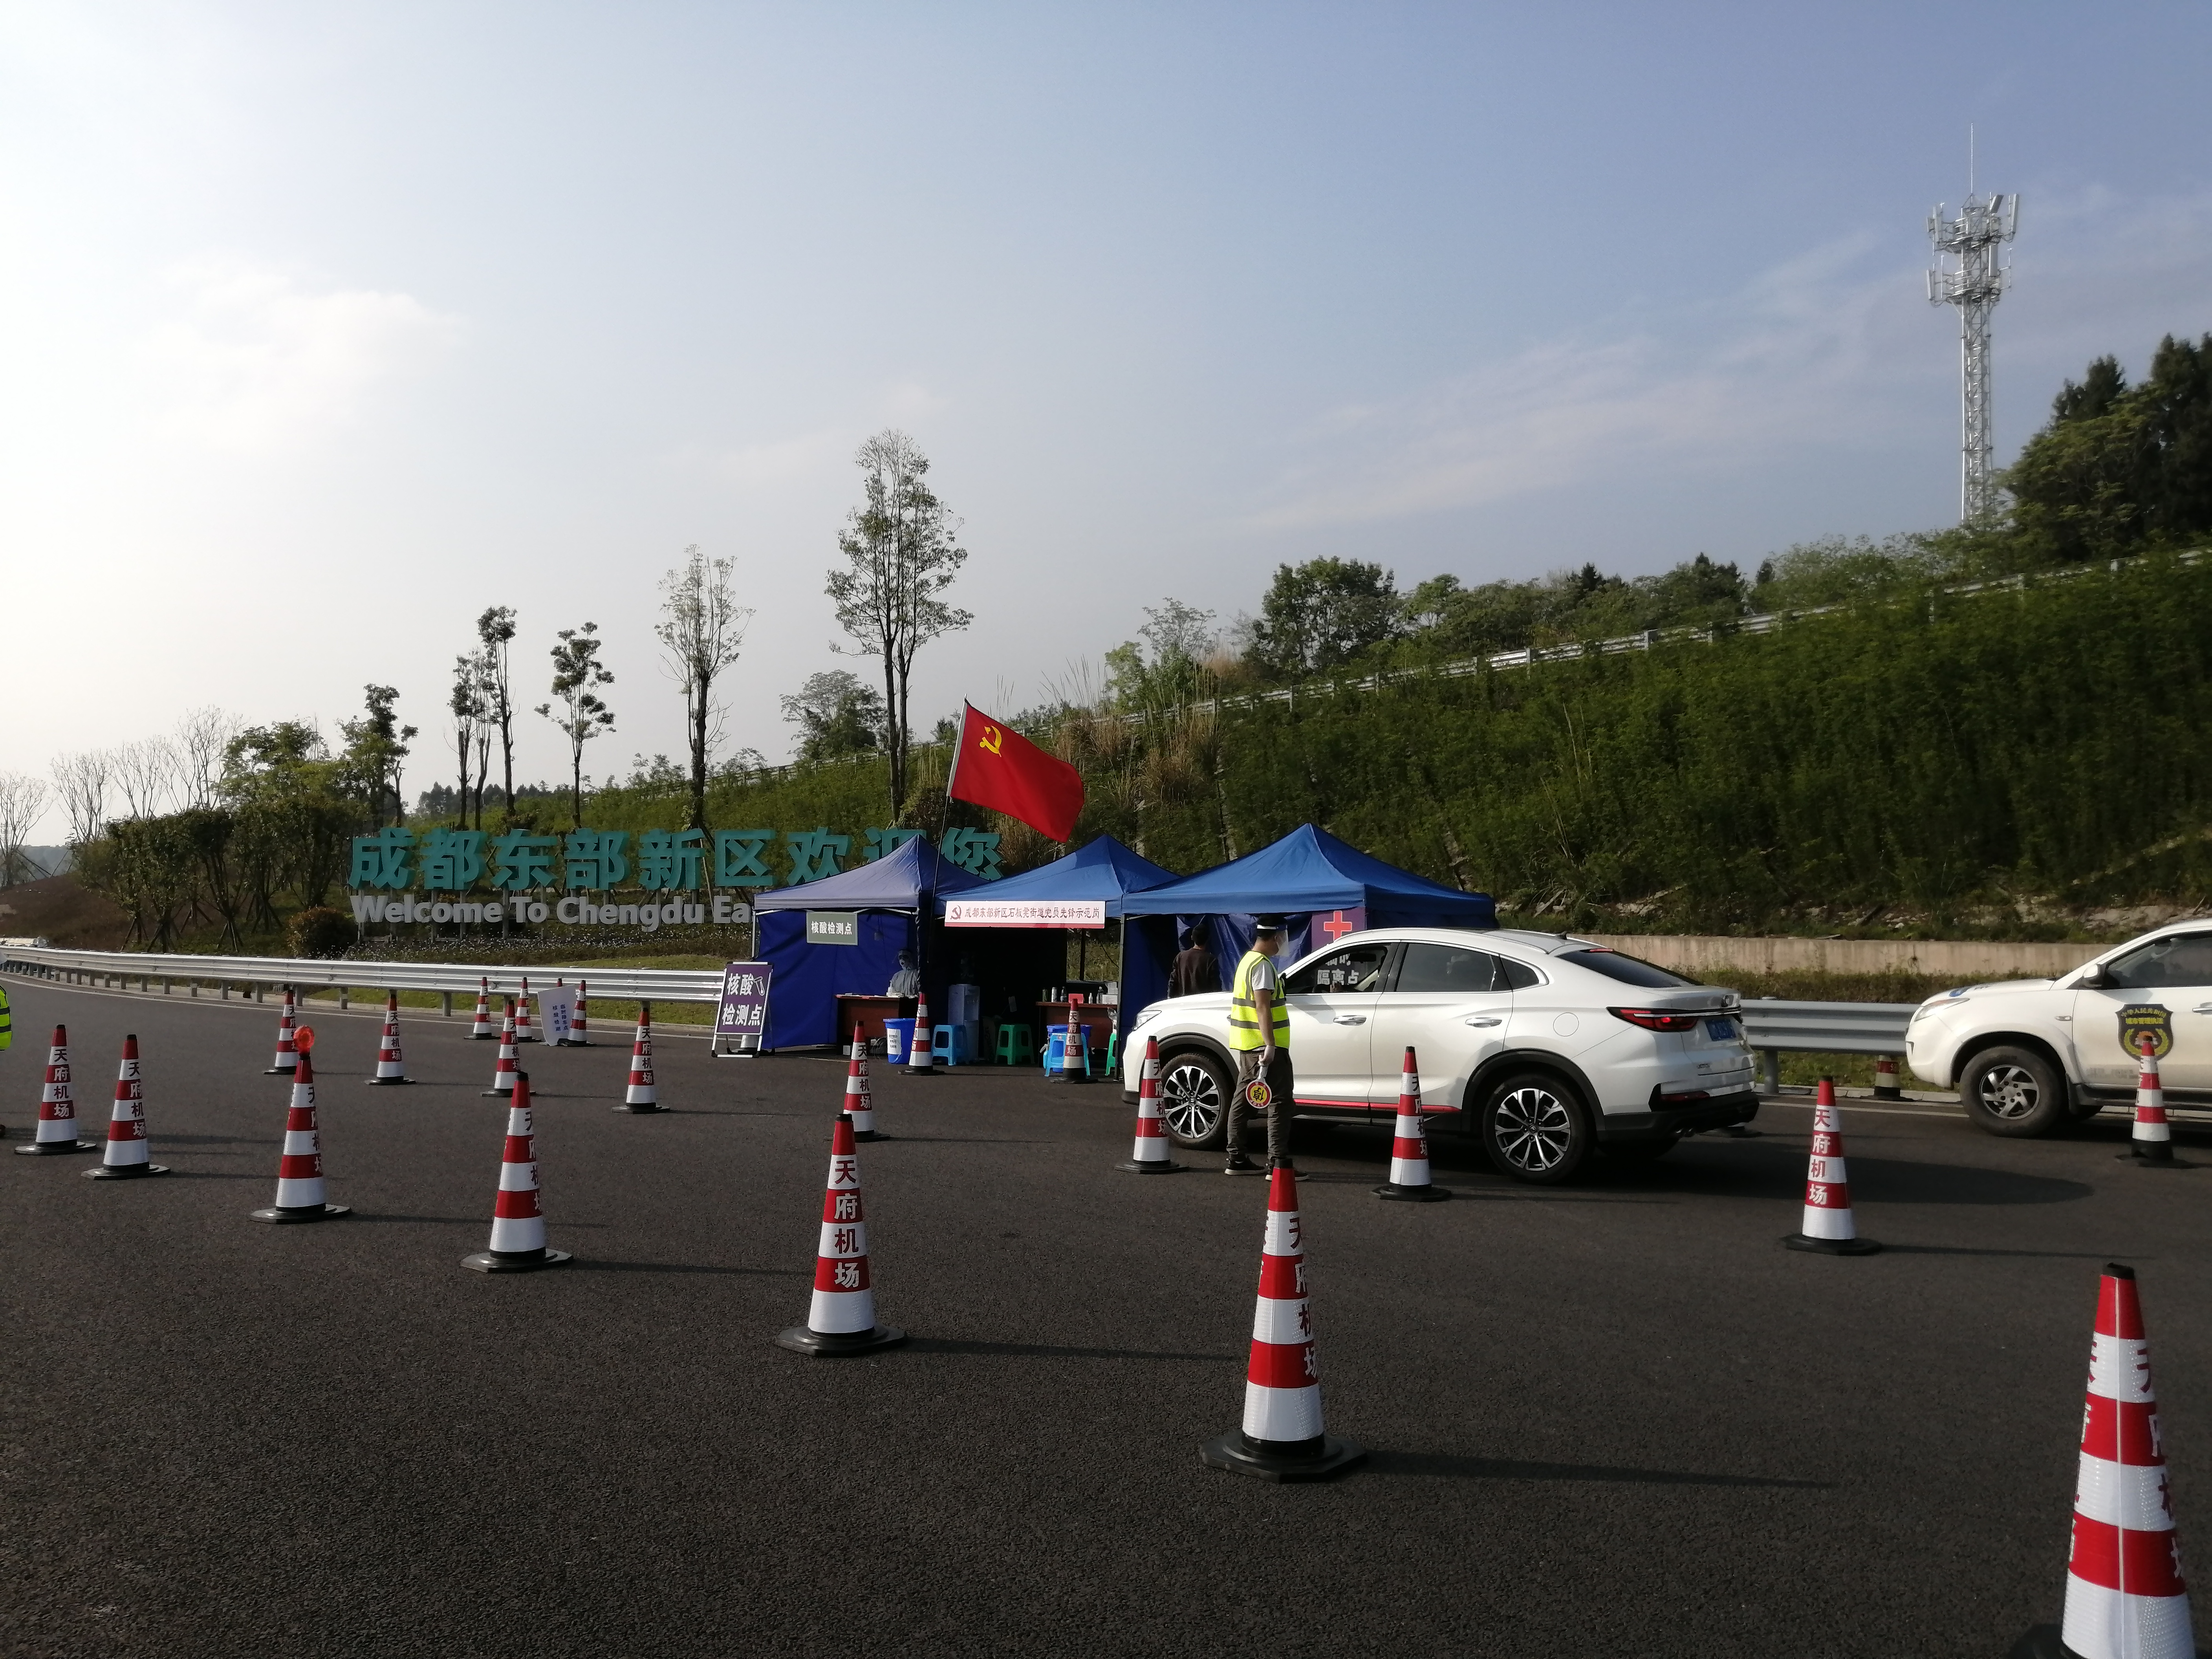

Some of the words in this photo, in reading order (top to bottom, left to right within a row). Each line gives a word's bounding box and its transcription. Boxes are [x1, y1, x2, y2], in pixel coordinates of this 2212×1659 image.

[350, 894, 503, 924] Welcome
[509, 897, 549, 924] To
[557, 894, 705, 932] Chengdu
[811, 921, 852, 935] 核酸检测点
[727, 973, 754, 996] 核酸
[390, 1012, 402, 1060] 天府机场
[722, 1003, 762, 1026] 检测点
[1067, 1012, 1077, 1056] 天府机场
[642, 1028, 653, 1084] 天府机场
[858, 1045, 871, 1109] 天府机场
[54, 1048, 69, 1117] 天府机场
[128, 1062, 146, 1137] 天府机场
[1253, 1087, 1264, 1101] 停
[1809, 1109, 1831, 1205] 天府机场
[835, 1160, 859, 1288] 天府机场
